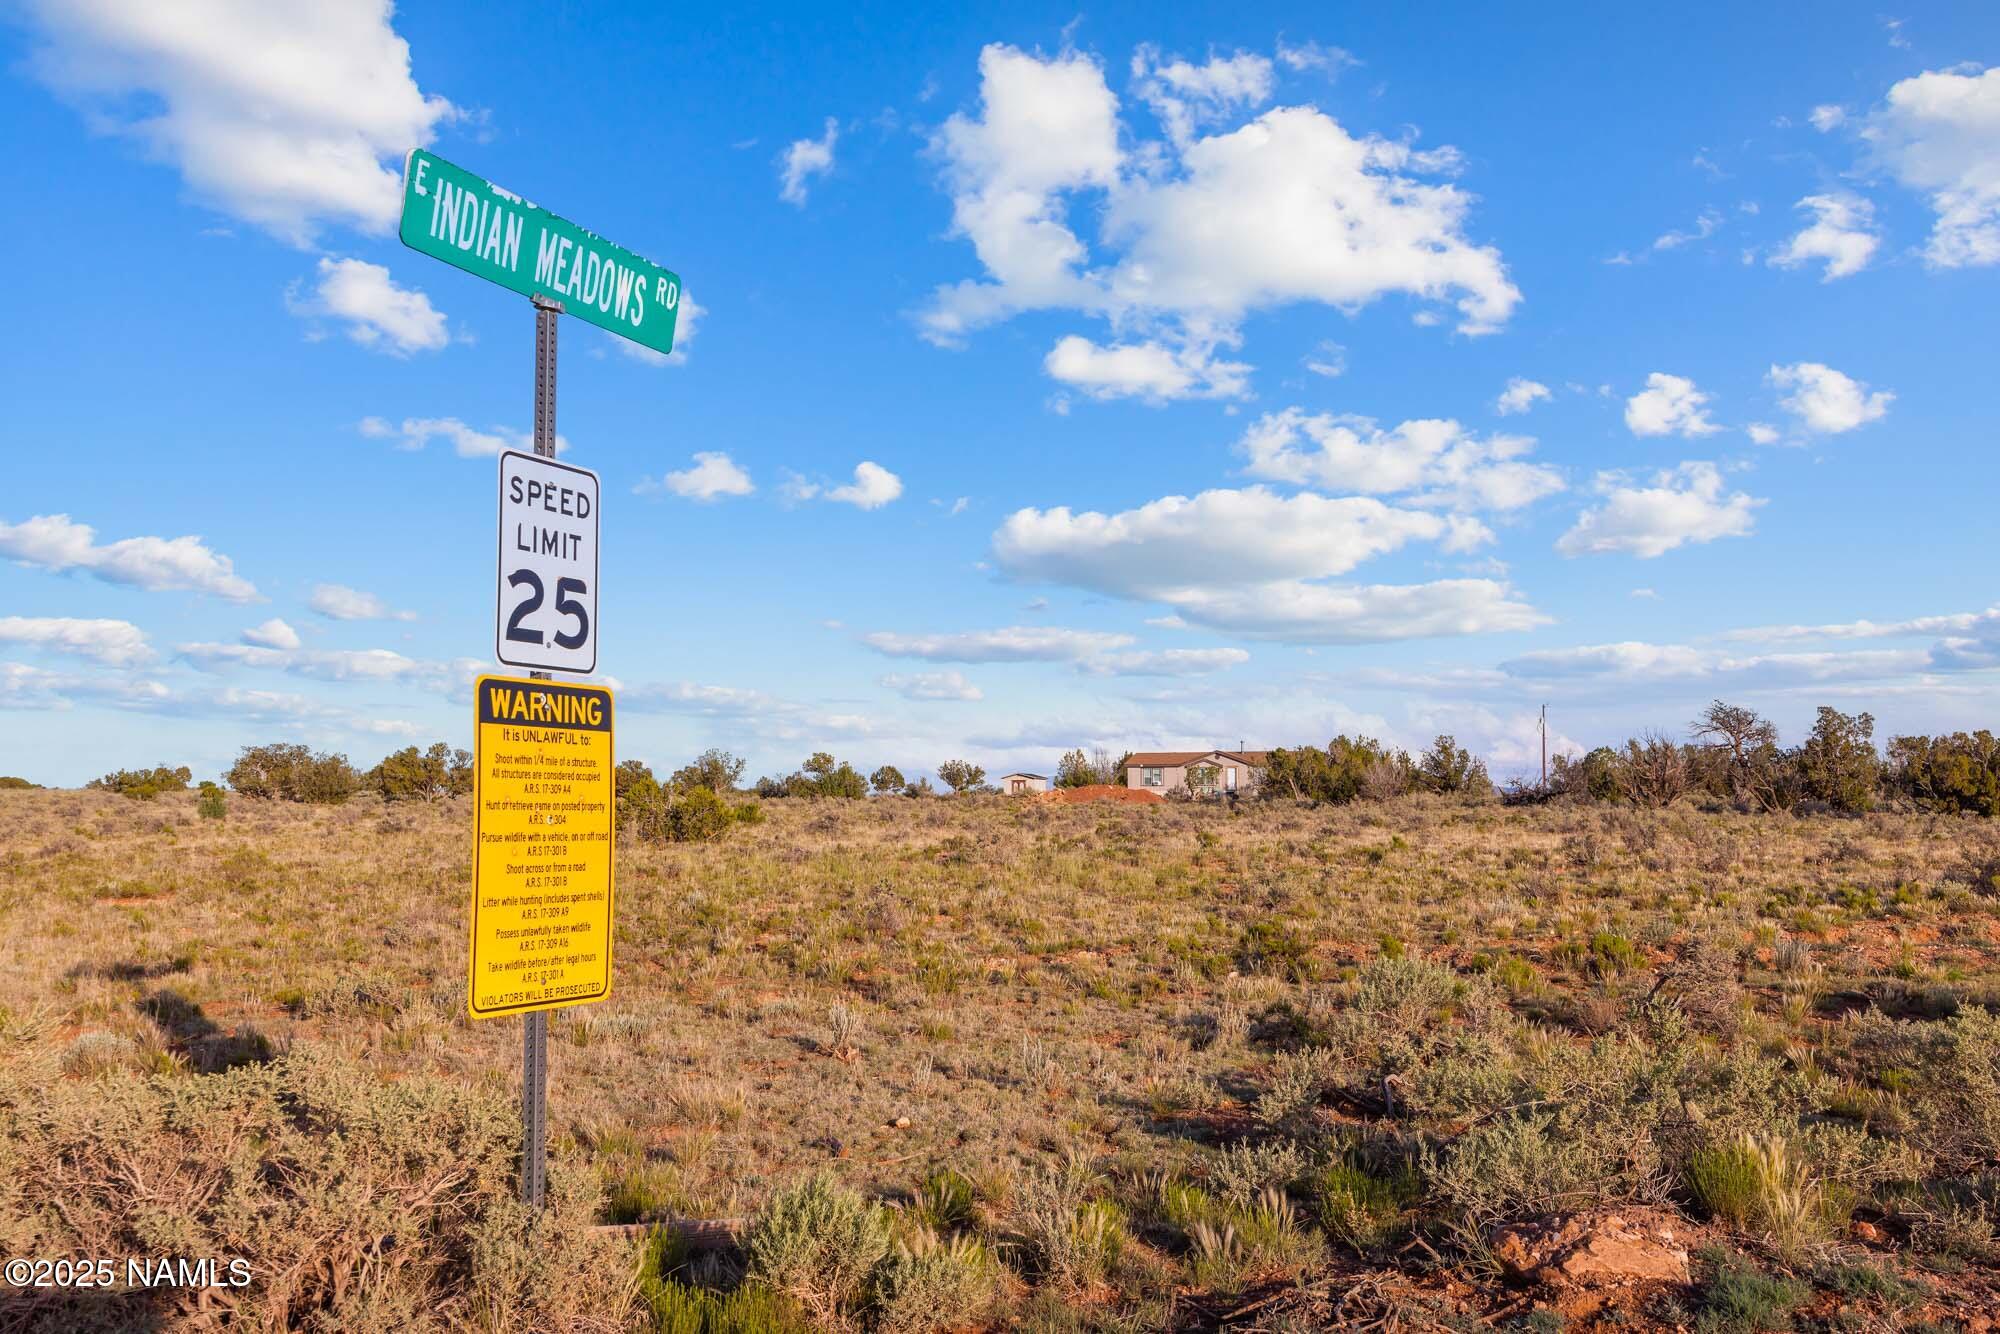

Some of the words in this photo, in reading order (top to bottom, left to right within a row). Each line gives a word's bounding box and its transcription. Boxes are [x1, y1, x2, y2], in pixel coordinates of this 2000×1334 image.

[414, 158, 430, 196] E
[430, 178, 523, 272] INDIAN
[534, 228, 646, 327] MEADOWS
[656, 276, 677, 310] RD
[510, 476, 590, 519] SPEED
[518, 523, 581, 561] LIMIT
[506, 569, 589, 649] 25
[490, 688, 602, 726] WARNING
[503, 728, 509, 740] It
[513, 730, 519, 741] is
[522, 730, 577, 745] UNLAWFUL
[581, 734, 591, 746] to:
[495, 753, 512, 764] Shoot
[514, 755, 532, 765] within
[534, 755, 544, 765] 1/4
[546, 756, 557, 765] mile
[560, 757, 566, 766] of
[501, 769, 531, 779] structures
[533, 771, 542, 779] are
[544, 770, 574, 780] considered
[576, 772, 600, 783] occupied
[542, 785, 561, 794] 17-309
[486, 800, 500, 810] Hunt
[502, 802, 508, 810] or
[509, 801, 532, 810] retrieve
[535, 802, 551, 812] game
[561, 802, 580, 812] posted
[582, 802, 605, 813] property
[482, 833, 502, 842] Pursue
[505, 832, 526, 842] wildlife
[528, 832, 541, 842] with
[596, 832, 608, 840] road
[506, 864, 523, 874] Shoot
[526, 864, 544, 873] across
[554, 862, 566, 872] from
[573, 862, 586, 871] road
[483, 897, 500, 907] Litter
[502, 897, 517, 906] while
[520, 895, 542, 906] hunting
[544, 894, 569, 903] (includes
[571, 893, 585, 904] spent
[587, 892, 605, 901] shells)
[541, 908, 560, 918] 17-309
[561, 907, 569, 916] A9
[496, 929, 519, 939] Possess
[521, 925, 551, 937] unlawfully
[553, 924, 569, 934] taken
[571, 922, 591, 932] wildlife
[539, 939, 557, 949] 17-309
[488, 962, 502, 973] Take
[505, 960, 526, 971] wildlife
[566, 955, 579, 965] legal
[581, 953, 596, 962] hours
[482, 992, 523, 1005] VIOLATORS
[526, 990, 542, 1000] WILL
[545, 988, 553, 998] BE
[556, 982, 600, 996] PROSECUTED
